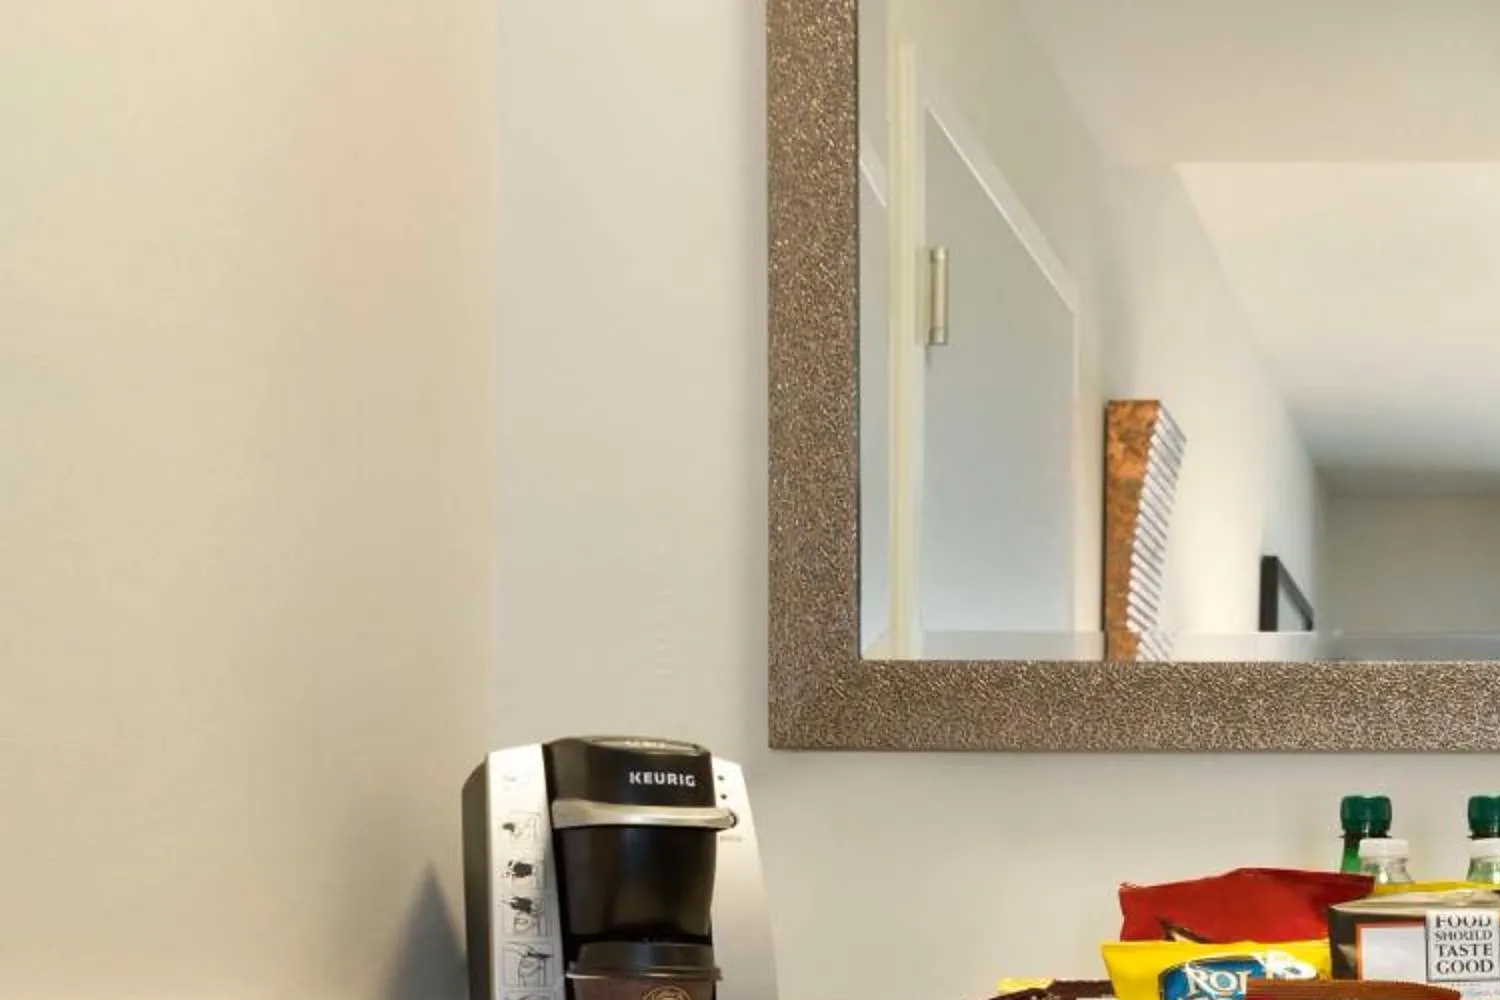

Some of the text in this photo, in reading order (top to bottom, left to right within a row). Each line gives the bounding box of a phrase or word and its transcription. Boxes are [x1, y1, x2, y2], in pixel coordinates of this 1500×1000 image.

[629, 771, 697, 787] KEURIG
[1436, 914, 1491, 928] FOOD
[1435, 929, 1493, 942] SHOULD
[1434, 943, 1493, 957] TASTE
[1437, 959, 1494, 975] GOOD
[1186, 963, 1248, 998] ROL
